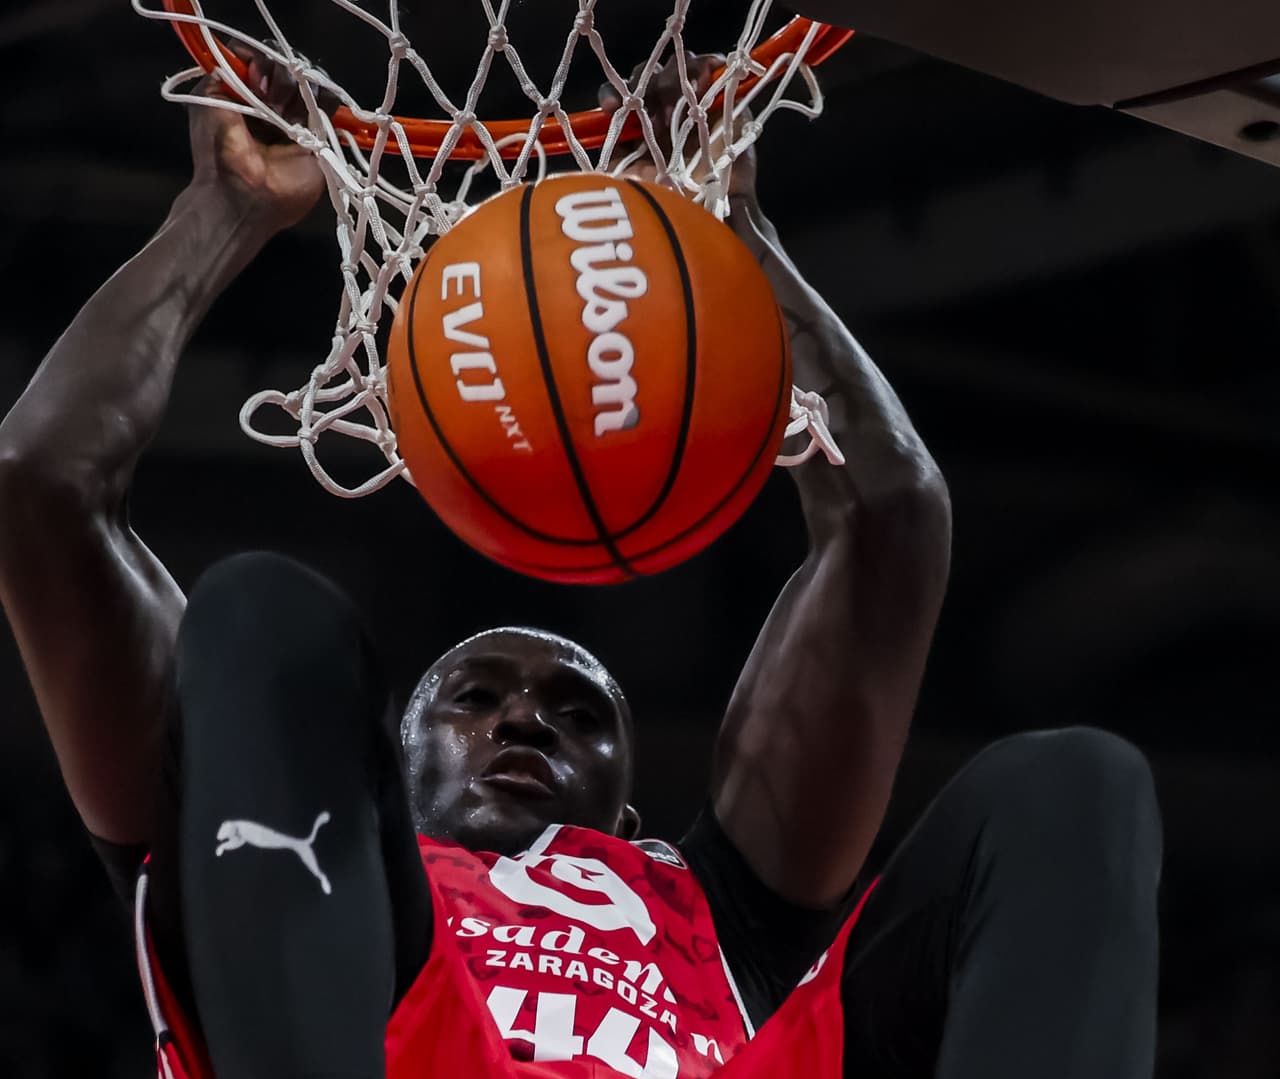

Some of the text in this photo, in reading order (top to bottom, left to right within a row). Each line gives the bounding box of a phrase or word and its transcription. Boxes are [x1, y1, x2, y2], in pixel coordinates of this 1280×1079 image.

[554, 187, 648, 438] Wilson
[494, 405, 532, 454] NXT
[485, 949, 677, 1033] ZARAGOZA
